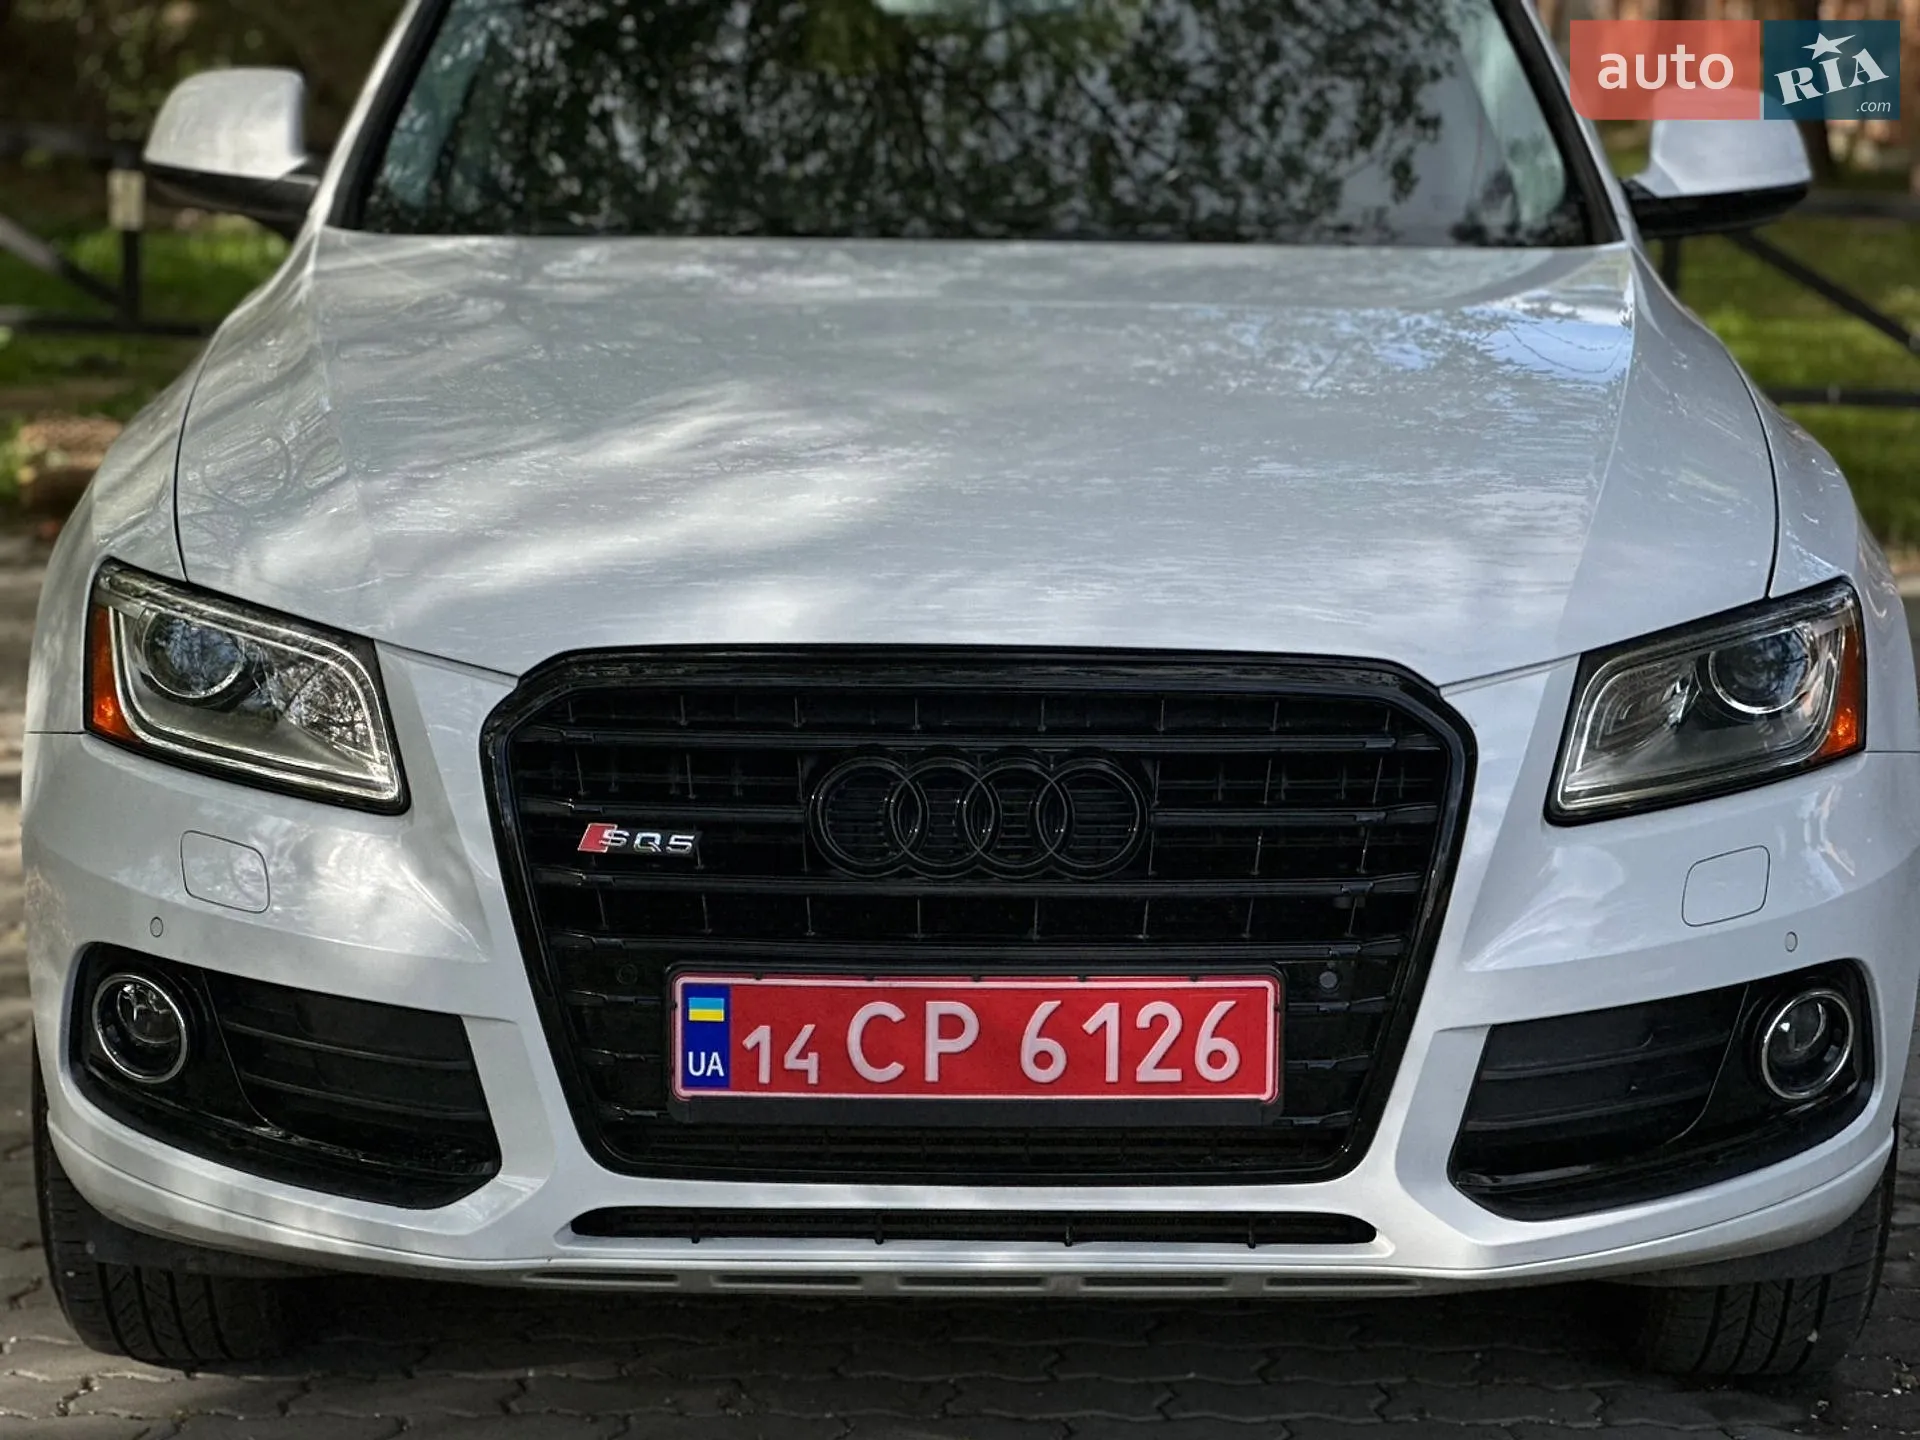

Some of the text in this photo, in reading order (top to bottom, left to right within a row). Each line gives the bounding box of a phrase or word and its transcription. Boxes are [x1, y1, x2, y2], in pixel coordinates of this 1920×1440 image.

[687, 1052, 725, 1077] UA
[742, 1001, 1241, 1084] 14 CP 6126
